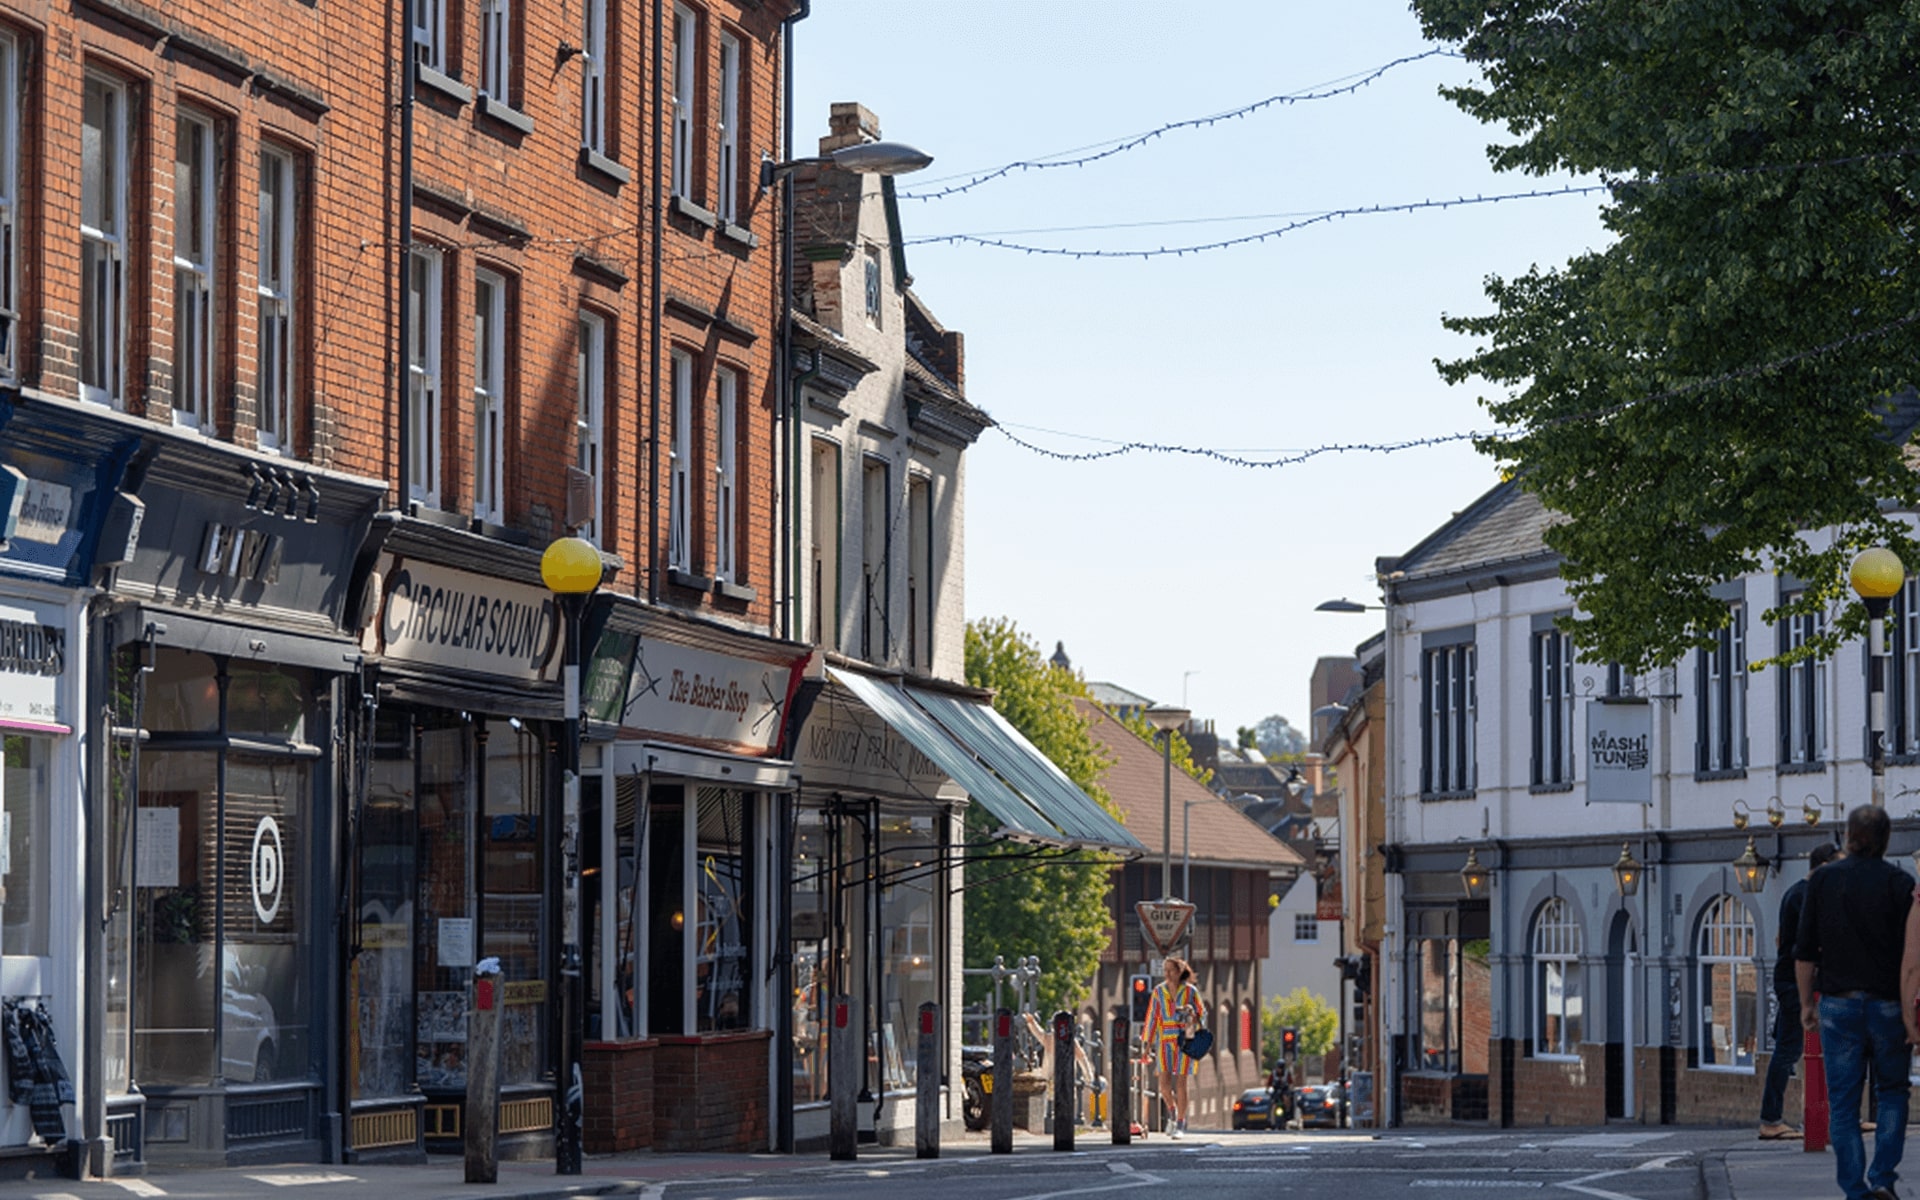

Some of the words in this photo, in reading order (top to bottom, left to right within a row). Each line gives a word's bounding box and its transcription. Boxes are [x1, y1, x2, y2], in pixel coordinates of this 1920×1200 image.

[669, 669, 690, 704] The
[690, 674, 725, 711] Barber
[724, 681, 749, 722] Shop
[1591, 736, 1641, 751] MASH
[1591, 750, 1627, 765] TUN
[1150, 910, 1181, 921] GIVE
